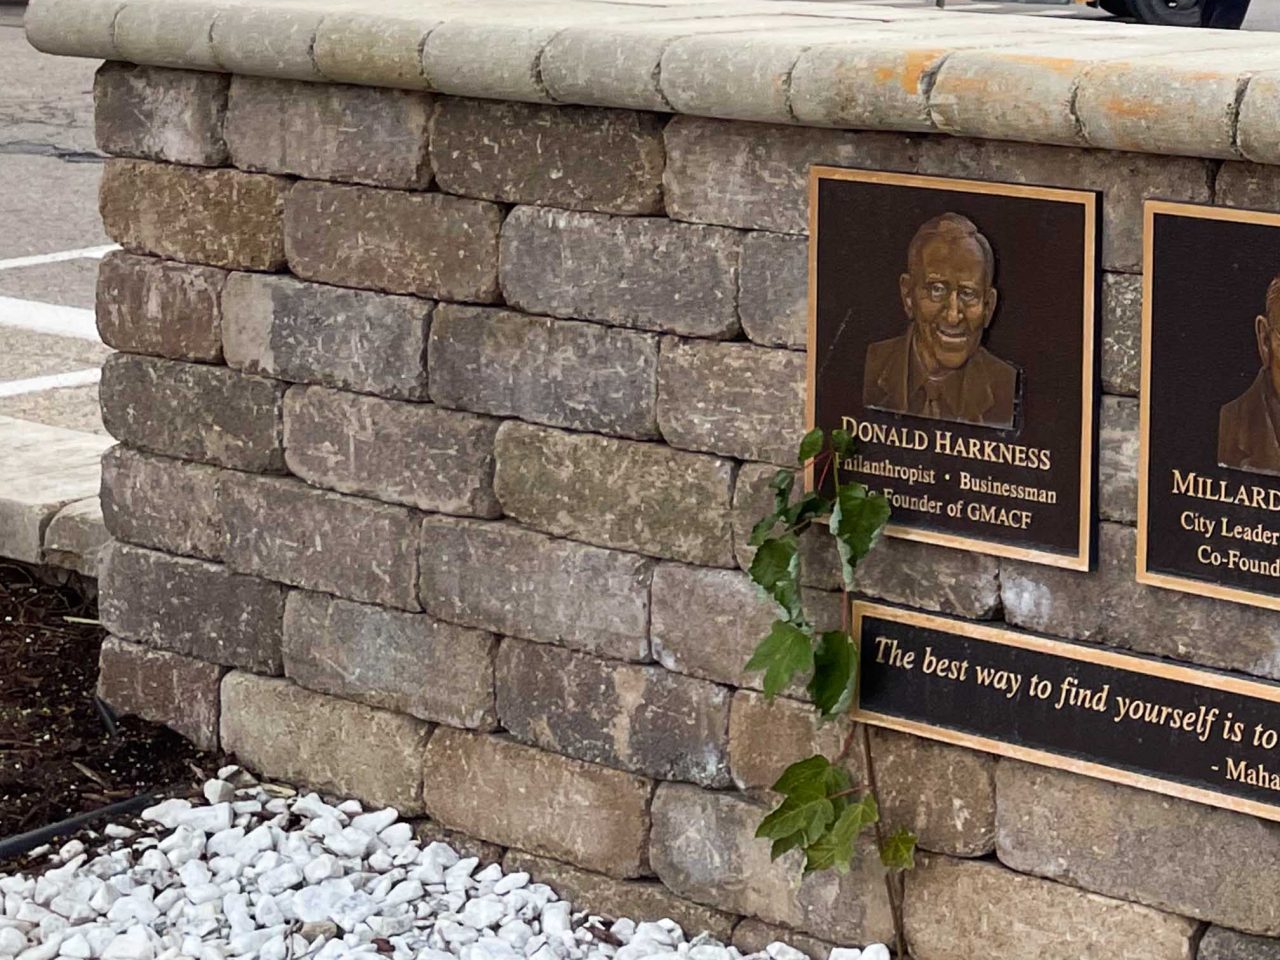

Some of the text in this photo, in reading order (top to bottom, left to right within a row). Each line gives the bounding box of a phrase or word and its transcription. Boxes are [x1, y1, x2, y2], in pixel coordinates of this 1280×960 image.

[841, 416, 1051, 471] DONALD HARKNESS
[960, 471, 1057, 504] Businessman
[947, 501, 962, 518] of
[967, 502, 1032, 529] GMACF
[1180, 511, 1215, 537] City
[1221, 517, 1280, 546] Leader
[875, 636, 915, 670] The
[922, 646, 969, 681] best
[975, 665, 1022, 698] way
[1029, 674, 1052, 699] to
[1055, 677, 1110, 712] find
[1114, 696, 1219, 741] yourself
[1223, 712, 1245, 742] is
[1253, 723, 1278, 749] to
